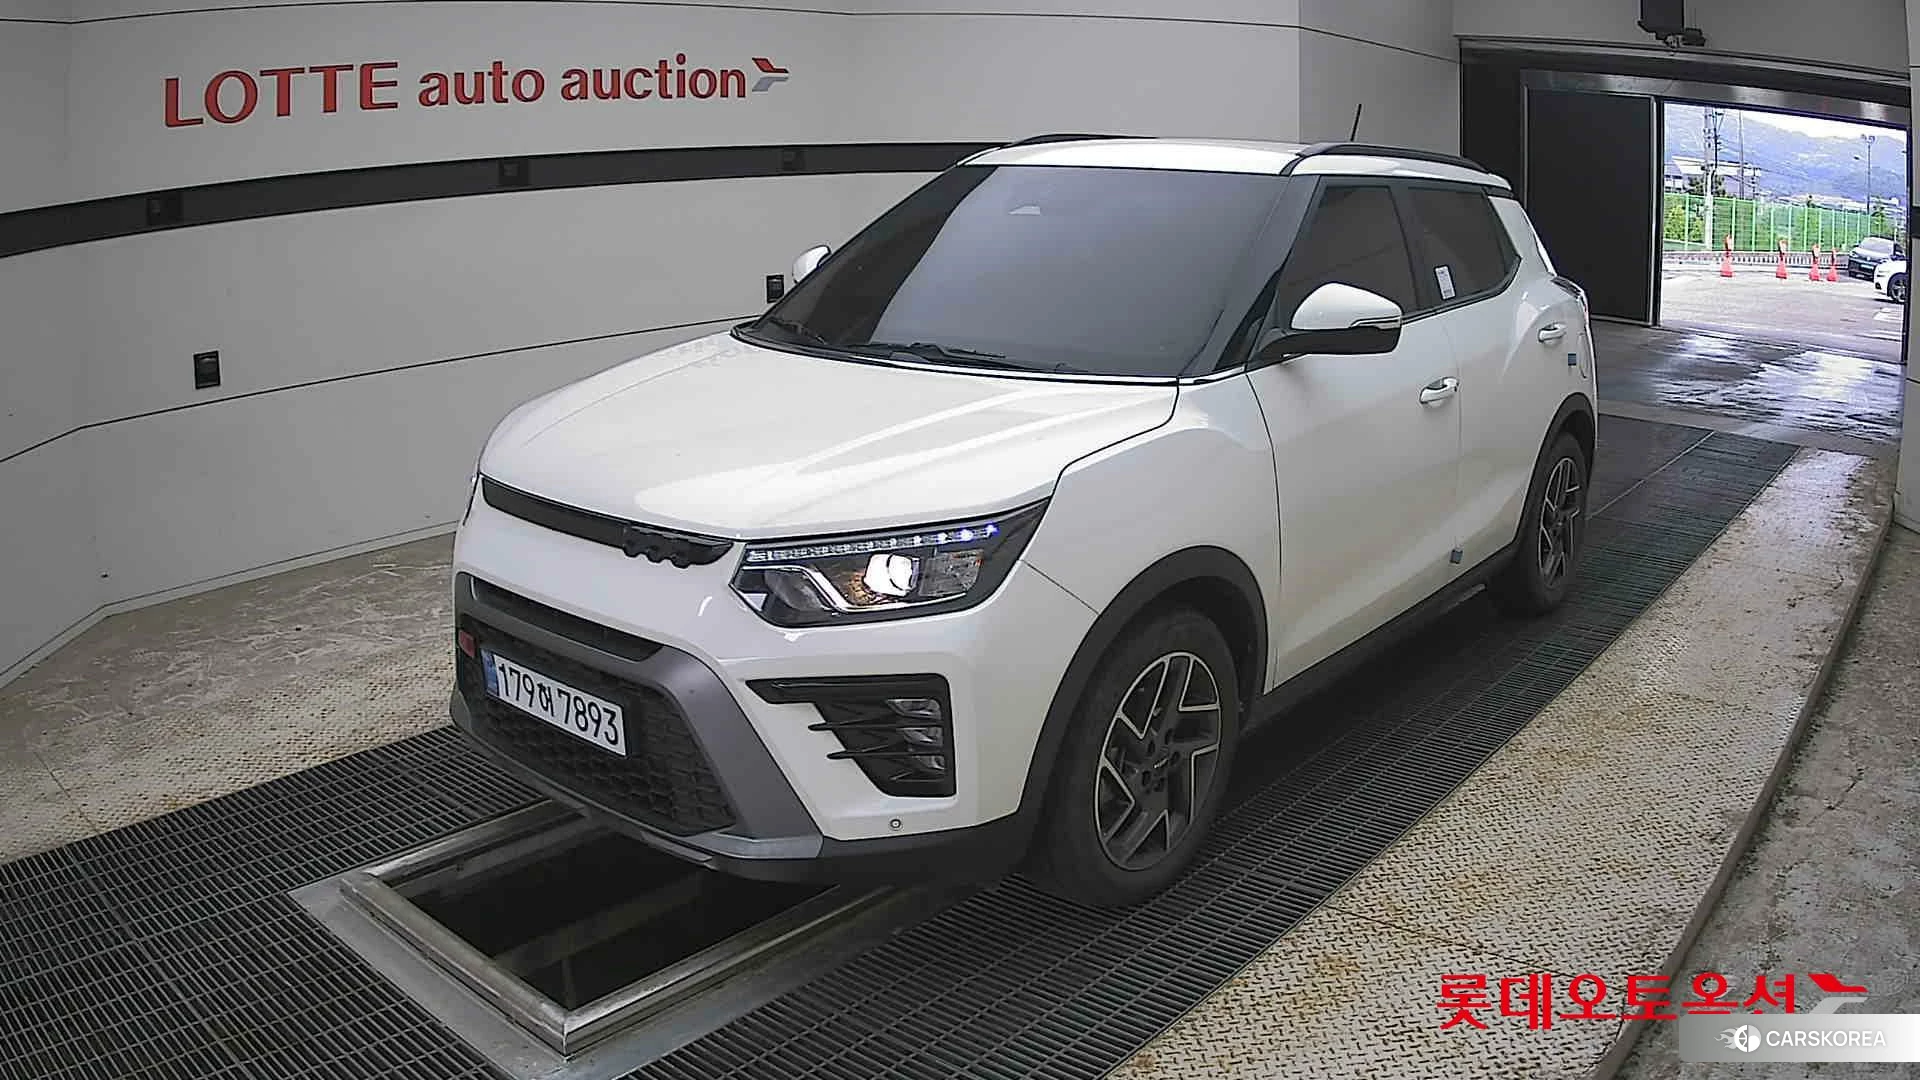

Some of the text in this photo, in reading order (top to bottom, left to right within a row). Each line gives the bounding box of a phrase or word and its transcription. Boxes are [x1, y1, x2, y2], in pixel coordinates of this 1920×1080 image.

[164, 53, 747, 128] LOTTE auto auction
[558, 686, 619, 746] 7893
